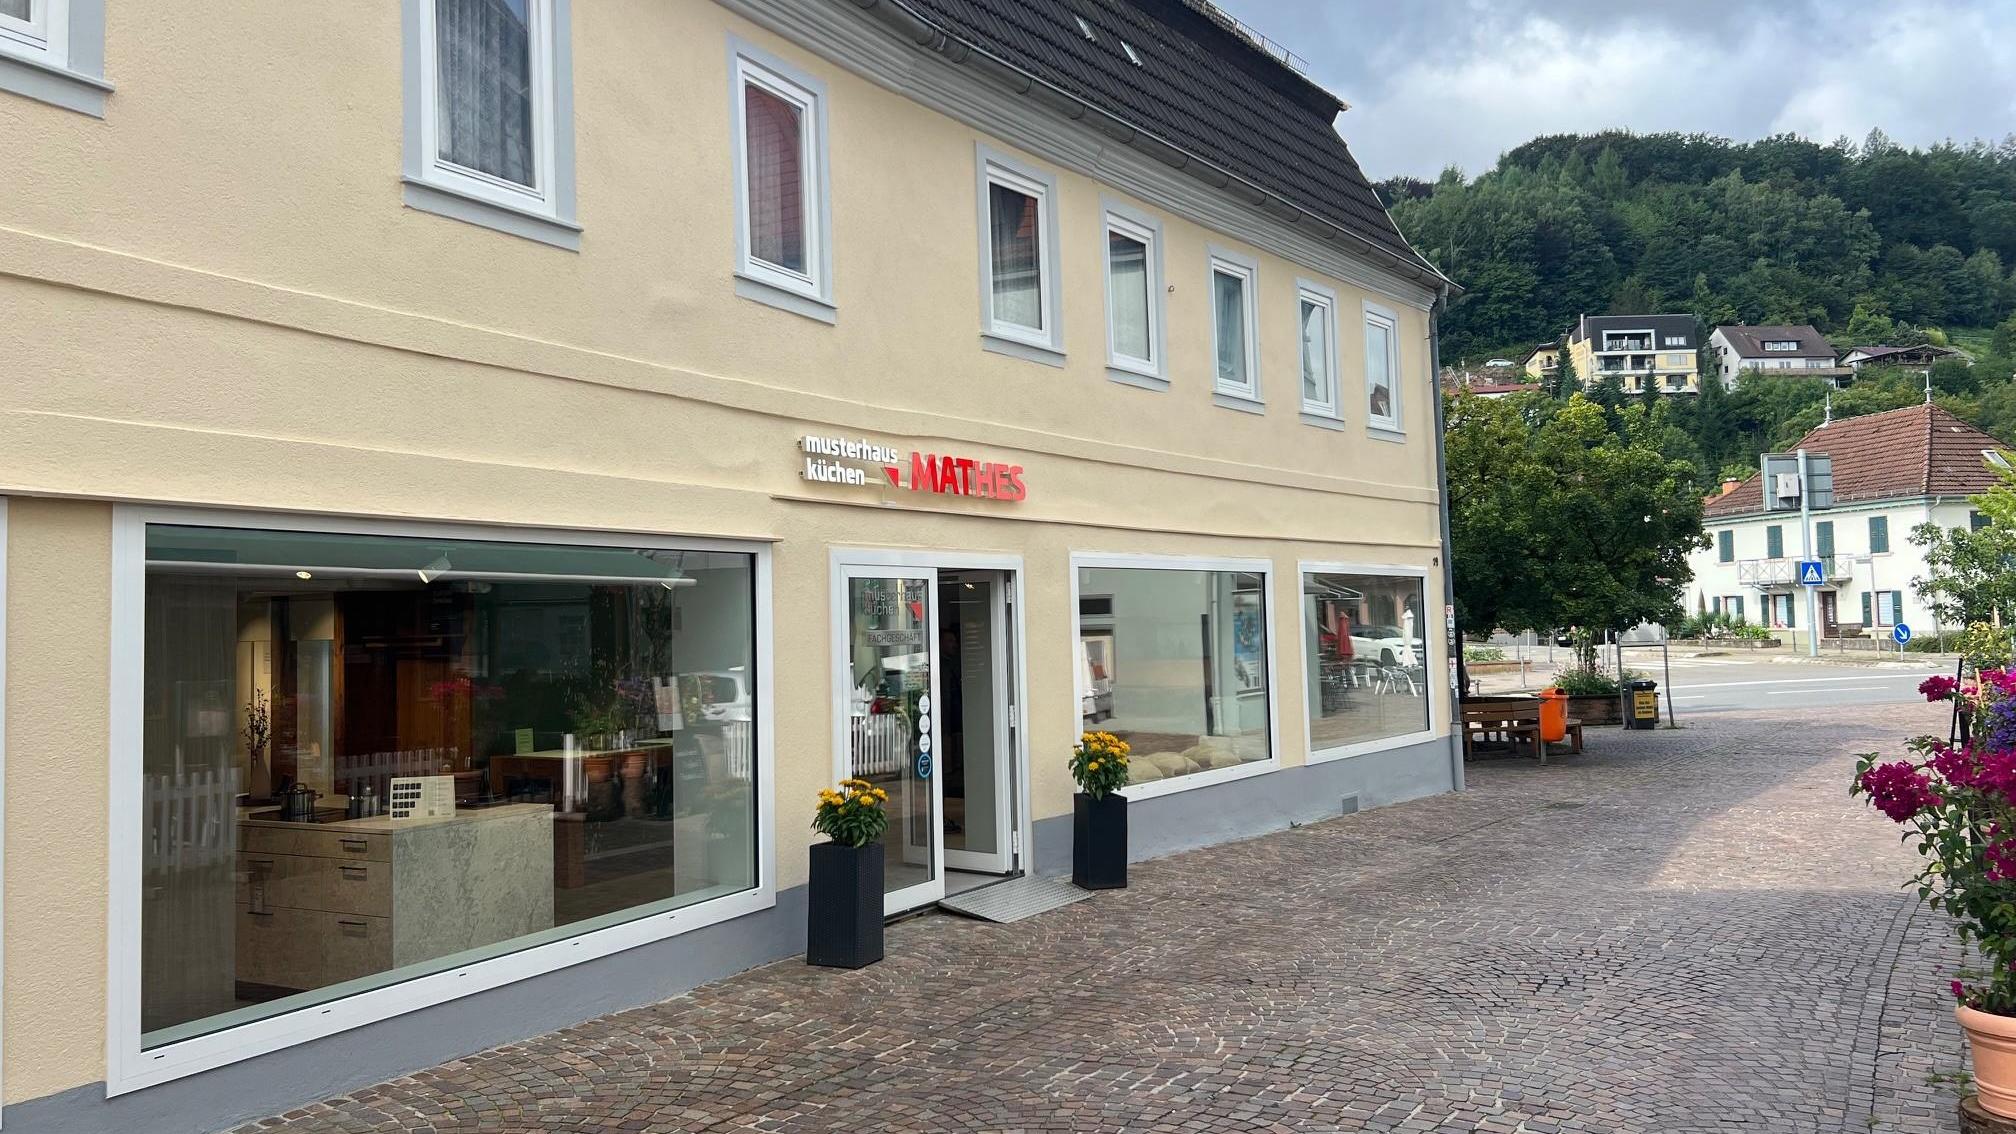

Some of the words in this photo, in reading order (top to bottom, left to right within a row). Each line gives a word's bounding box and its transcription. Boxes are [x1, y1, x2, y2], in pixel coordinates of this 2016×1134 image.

[805, 435, 898, 464] musterhaus
[806, 458, 865, 485] küchen
[911, 451, 1026, 501] MATHES
